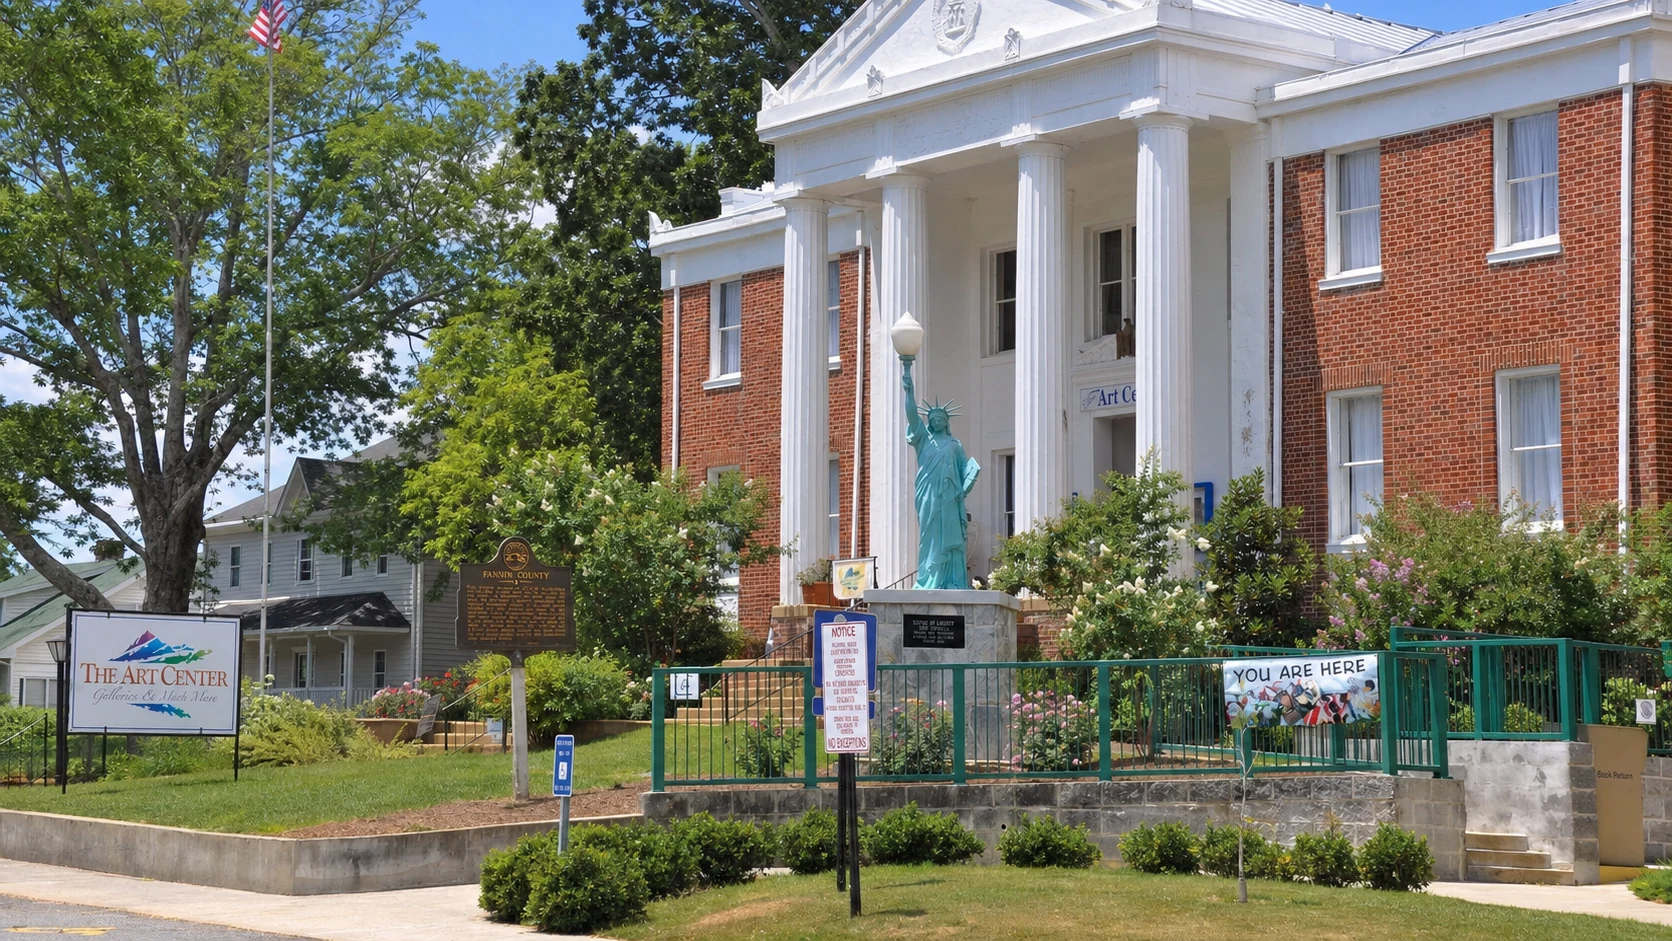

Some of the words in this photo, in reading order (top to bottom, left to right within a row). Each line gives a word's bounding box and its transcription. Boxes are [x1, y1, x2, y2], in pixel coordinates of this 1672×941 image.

[1098, 389, 1118, 406] Art
[832, 626, 855, 637] NOTICE
[80, 663, 118, 684] THE
[121, 665, 159, 685] ART
[161, 665, 228, 687] CENTER
[1233, 668, 1270, 683] YOU
[1279, 664, 1313, 679] ARE
[1321, 659, 1366, 676] HERE
[142, 689, 156, 701] &
